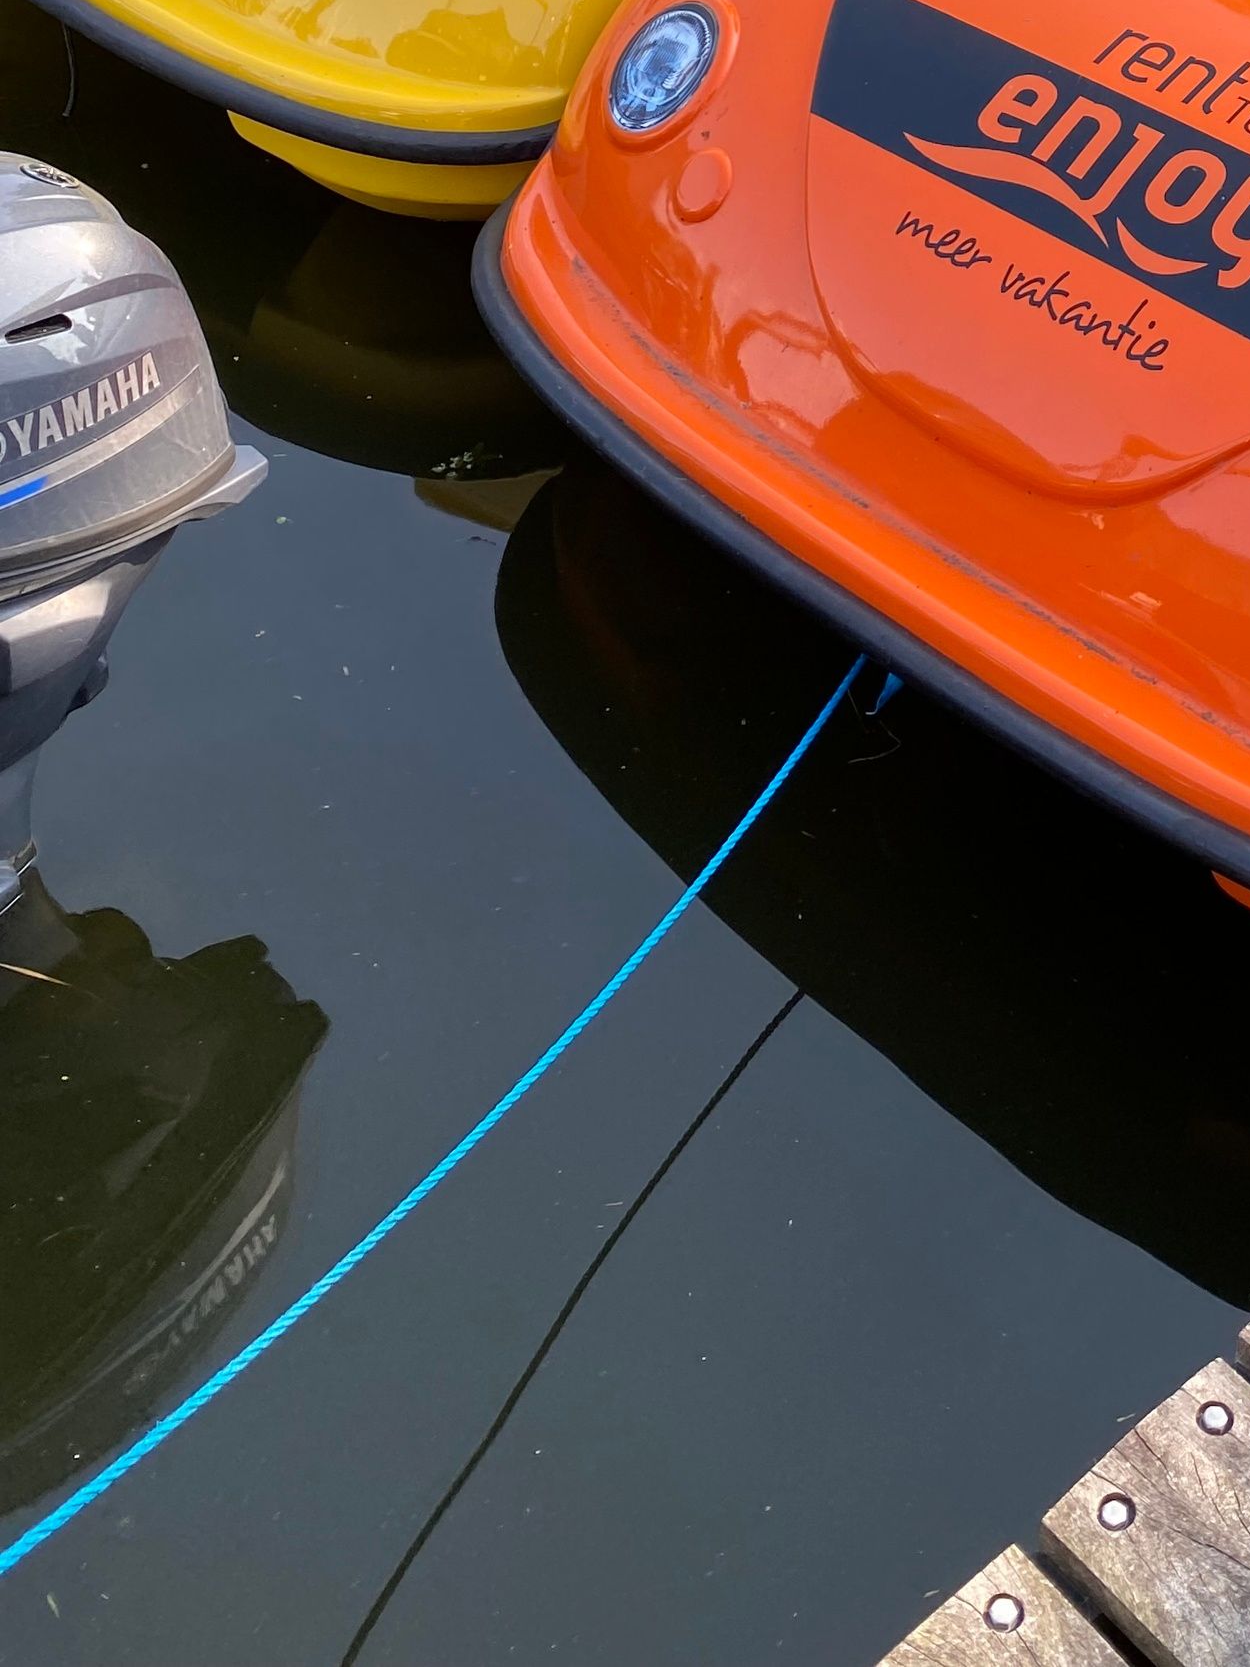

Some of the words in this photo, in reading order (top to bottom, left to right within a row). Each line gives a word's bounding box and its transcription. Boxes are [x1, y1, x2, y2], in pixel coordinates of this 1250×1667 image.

[895, 210, 992, 270] meer
[1000, 264, 1174, 372] vakantie
[6, 351, 161, 457] YAMAHA
